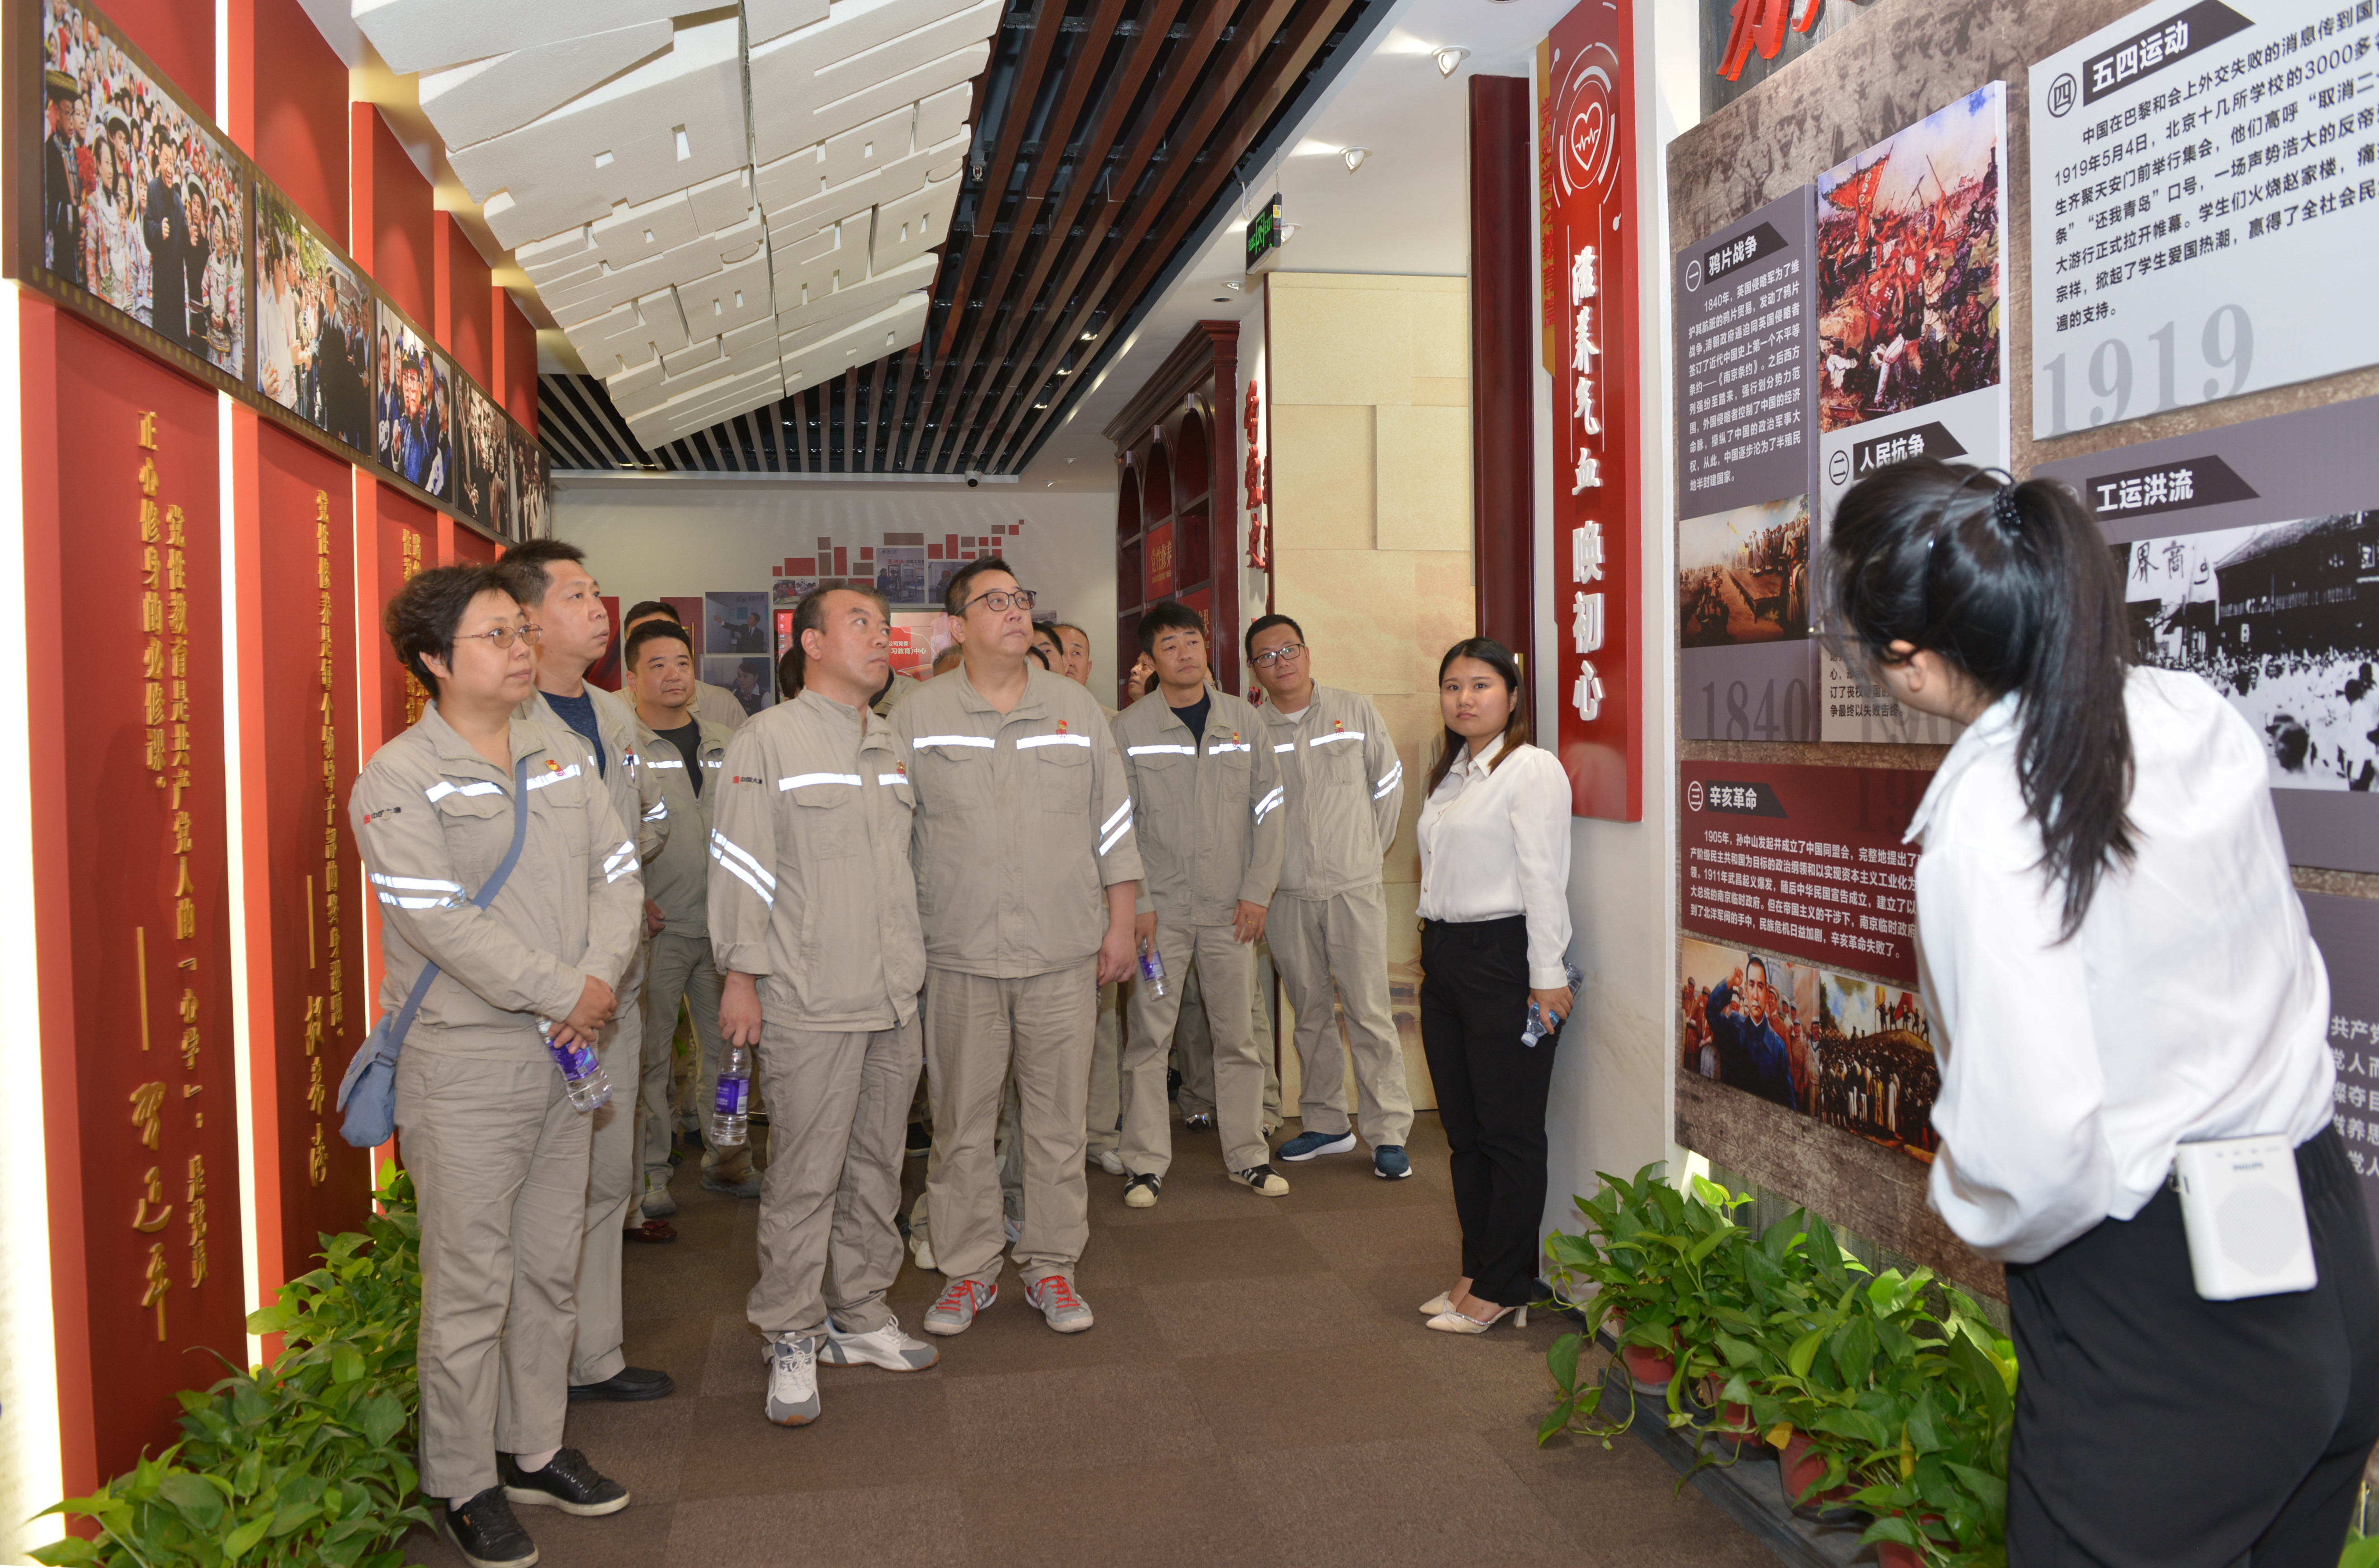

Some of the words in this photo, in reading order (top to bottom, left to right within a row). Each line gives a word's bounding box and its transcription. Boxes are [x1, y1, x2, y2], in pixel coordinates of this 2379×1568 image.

[2083, 0, 2379, 146] 中国在巴黎和会上外交失败的消息传到国
[2092, 21, 2189, 93] 五四运动
[2055, 31, 2379, 187] 1919年5月4日，北京十几所学校的3000多
[2055, 72, 2379, 217] 生齐聚天安门前举行集会，他们高呼“取消二
[2055, 104, 2379, 245] 条”“还我青岛”口号，一场声势浩大的反帝
[1265, 214, 1273, 235] EXIT
[2056, 143, 2379, 274] 大游行正式拉开帷幕。学生们火烧赵家楼，痛
[1709, 235, 1757, 276] 鸦片战争
[2056, 179, 2379, 303] 宗祥，掀起了学生爱国热潮，赢得了全社会民
[1704, 259, 1799, 312] 1840年，英国侵略军为了维
[2056, 301, 2116, 333] 遍的支持。
[1689, 323, 1800, 377] 签订了近代中国史上第一个不平等
[2043, 304, 2254, 439] 1919
[1860, 433, 1925, 472] 人民抗争
[1690, 470, 1734, 491] 地半封建国家。
[2096, 469, 2193, 512] 工运洪流
[1151, 540, 1171, 574] 党性修养
[1703, 678, 1812, 740] 1840
[1830, 703, 1903, 717] 争最终以失败告终。
[1709, 786, 1757, 810] 辛亥革命
